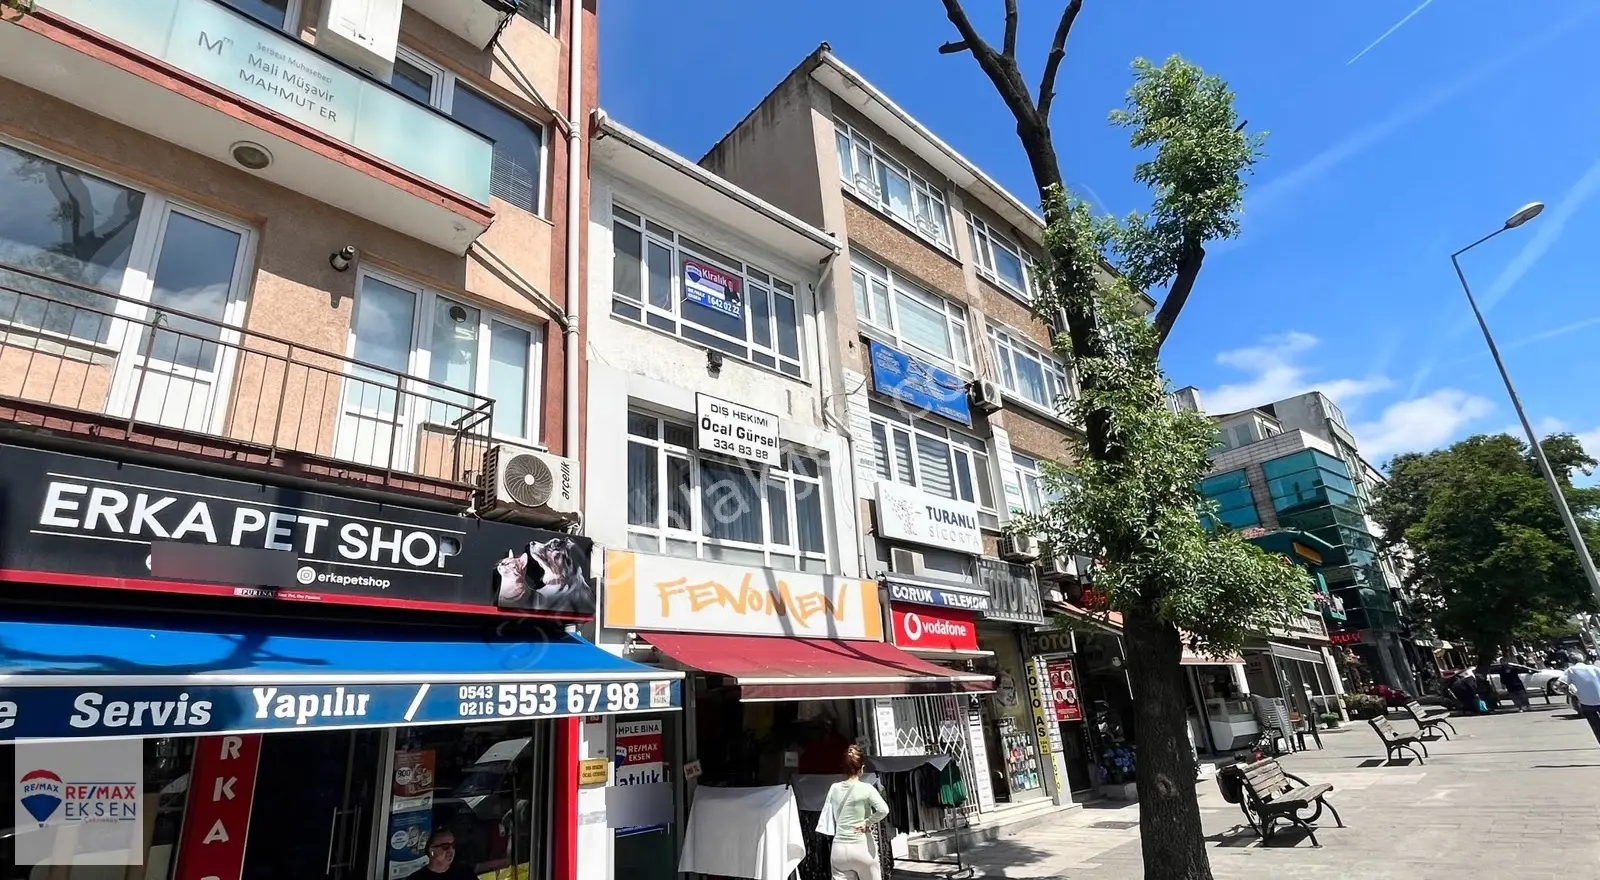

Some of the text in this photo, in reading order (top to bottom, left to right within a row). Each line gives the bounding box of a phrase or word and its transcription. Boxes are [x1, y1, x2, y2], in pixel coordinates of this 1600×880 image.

[248, 53, 335, 103] Mali Müşavir
[288, 57, 333, 84] Muhasebeci
[240, 69, 337, 122] MAHMUT ER
[711, 403, 769, 428] DİŞ HEKİMİ
[701, 414, 778, 449] Öcal Gürsel
[713, 438, 769, 460] 334 83 88
[560, 460, 572, 500] arçelik
[39, 481, 463, 569] ERKA PET SHOP
[925, 505, 977, 530] TURANLI
[242, 584, 273, 597] PURINA
[317, 571, 391, 589] erkapetshop
[654, 572, 848, 629] FENOMEN
[939, 592, 989, 610] TELEKOM
[922, 621, 967, 637] vodafone
[1030, 634, 1071, 651] FOTO
[459, 685, 494, 700] 0543
[498, 682, 639, 716] 553 67 98
[1026, 665, 1041, 709] FOTO
[1036, 716, 1046, 737] AS
[69, 692, 213, 728] Servis
[252, 687, 370, 725] Yapılır
[459, 701, 494, 716] 0216
[628, 742, 658, 754] RE/MAX
[628, 753, 651, 762] EKSEN
